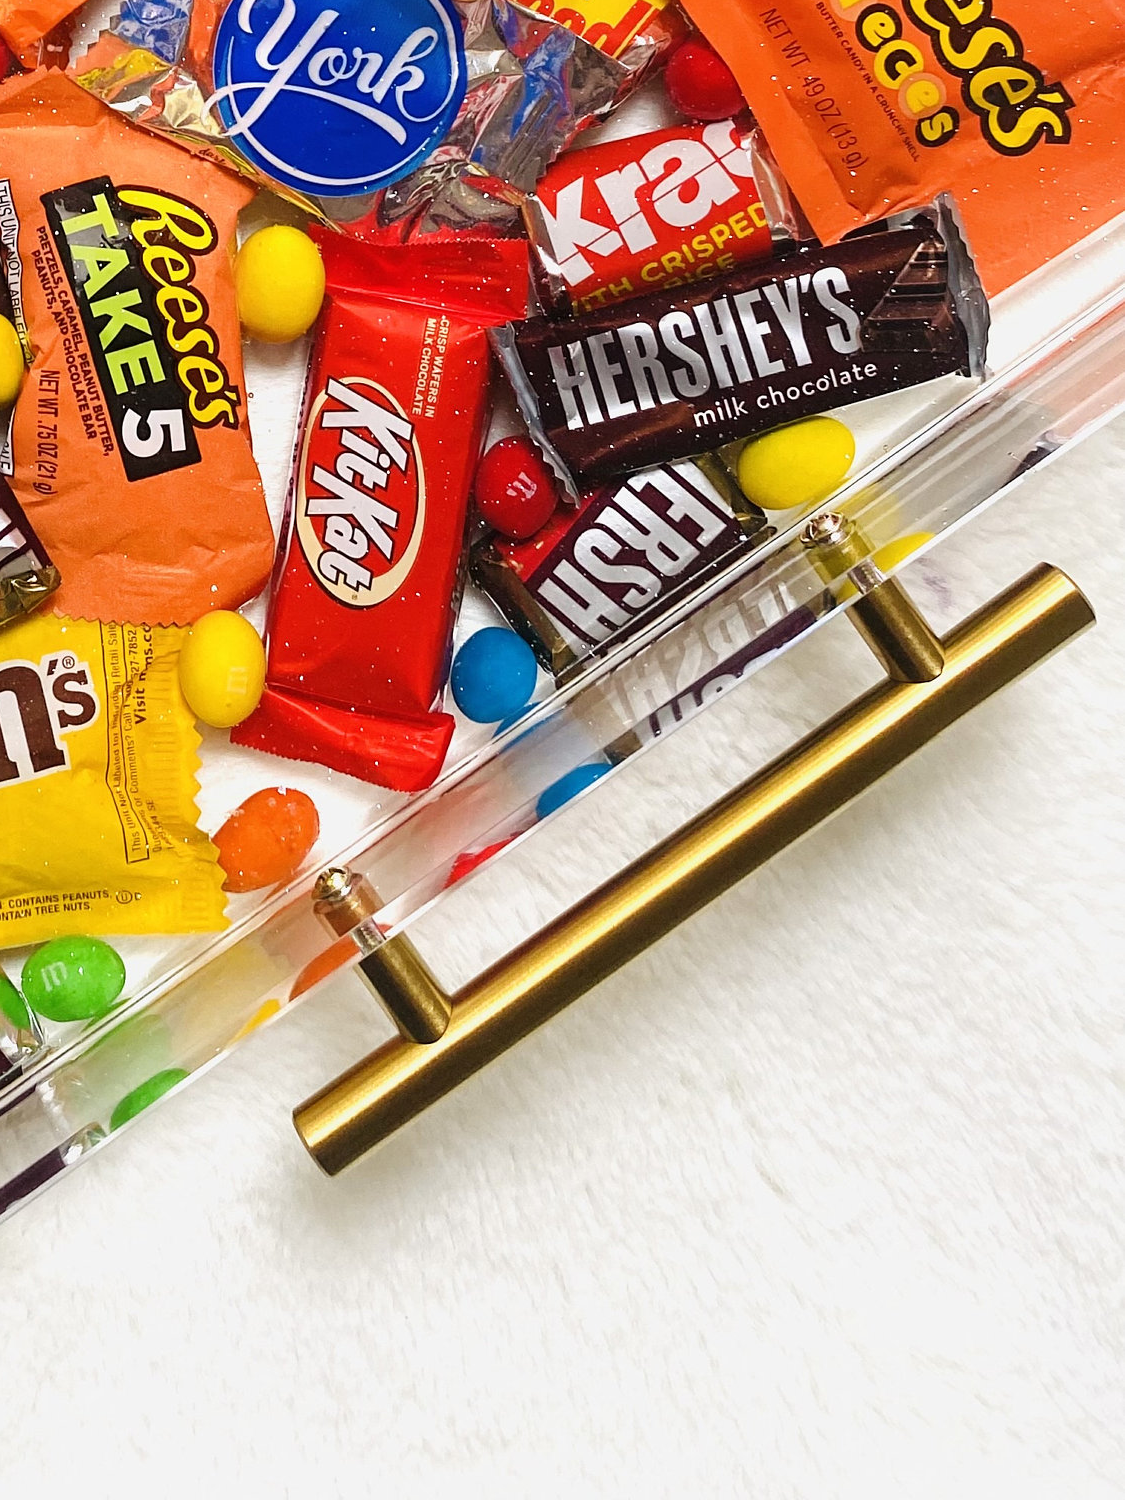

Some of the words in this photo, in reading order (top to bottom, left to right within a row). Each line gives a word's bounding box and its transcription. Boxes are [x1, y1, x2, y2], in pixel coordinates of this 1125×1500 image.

[759, 7, 792, 42] NET
[782, 39, 812, 68] WT
[816, 0, 847, 43] BUTTER
[841, 39, 866, 73] CANDY
[875, 93, 909, 142] CRUNCHY
[902, 138, 920, 163] SHELL
[814, 92, 843, 124] OZ
[828, 120, 860, 150] (13
[641, 202, 769, 283] CRISPED
[7, 254, 20, 278] NOT
[117, 188, 237, 425] Reese's
[36, 226, 63, 289] PRETZELS,
[58, 291, 86, 352] CARAMEL,
[78, 354, 100, 402] PEANUT
[92, 402, 115, 456] BUTTER,
[61, 193, 166, 395] TAKE
[121, 407, 187, 459] 5
[424, 317, 436, 345] MILK
[437, 319, 451, 352] CRISP
[32, 250, 54, 310] PEANUTS,
[52, 312, 68, 334] AND
[62, 337, 88, 411] CHOCOLATE
[82, 413, 97, 440] BAR
[548, 267, 861, 430] HERSHEY'S
[41, 369, 60, 395] NET
[412, 347, 431, 415] CHOCOLATE
[427, 354, 447, 404] WAFERS
[693, 398, 747, 427] milk
[757, 362, 878, 410] chocolate
[38, 398, 58, 419] WT
[133, 687, 147, 725] Visit
[9, 893, 59, 908] CONTAINS
[36, 903, 60, 915] TREE
